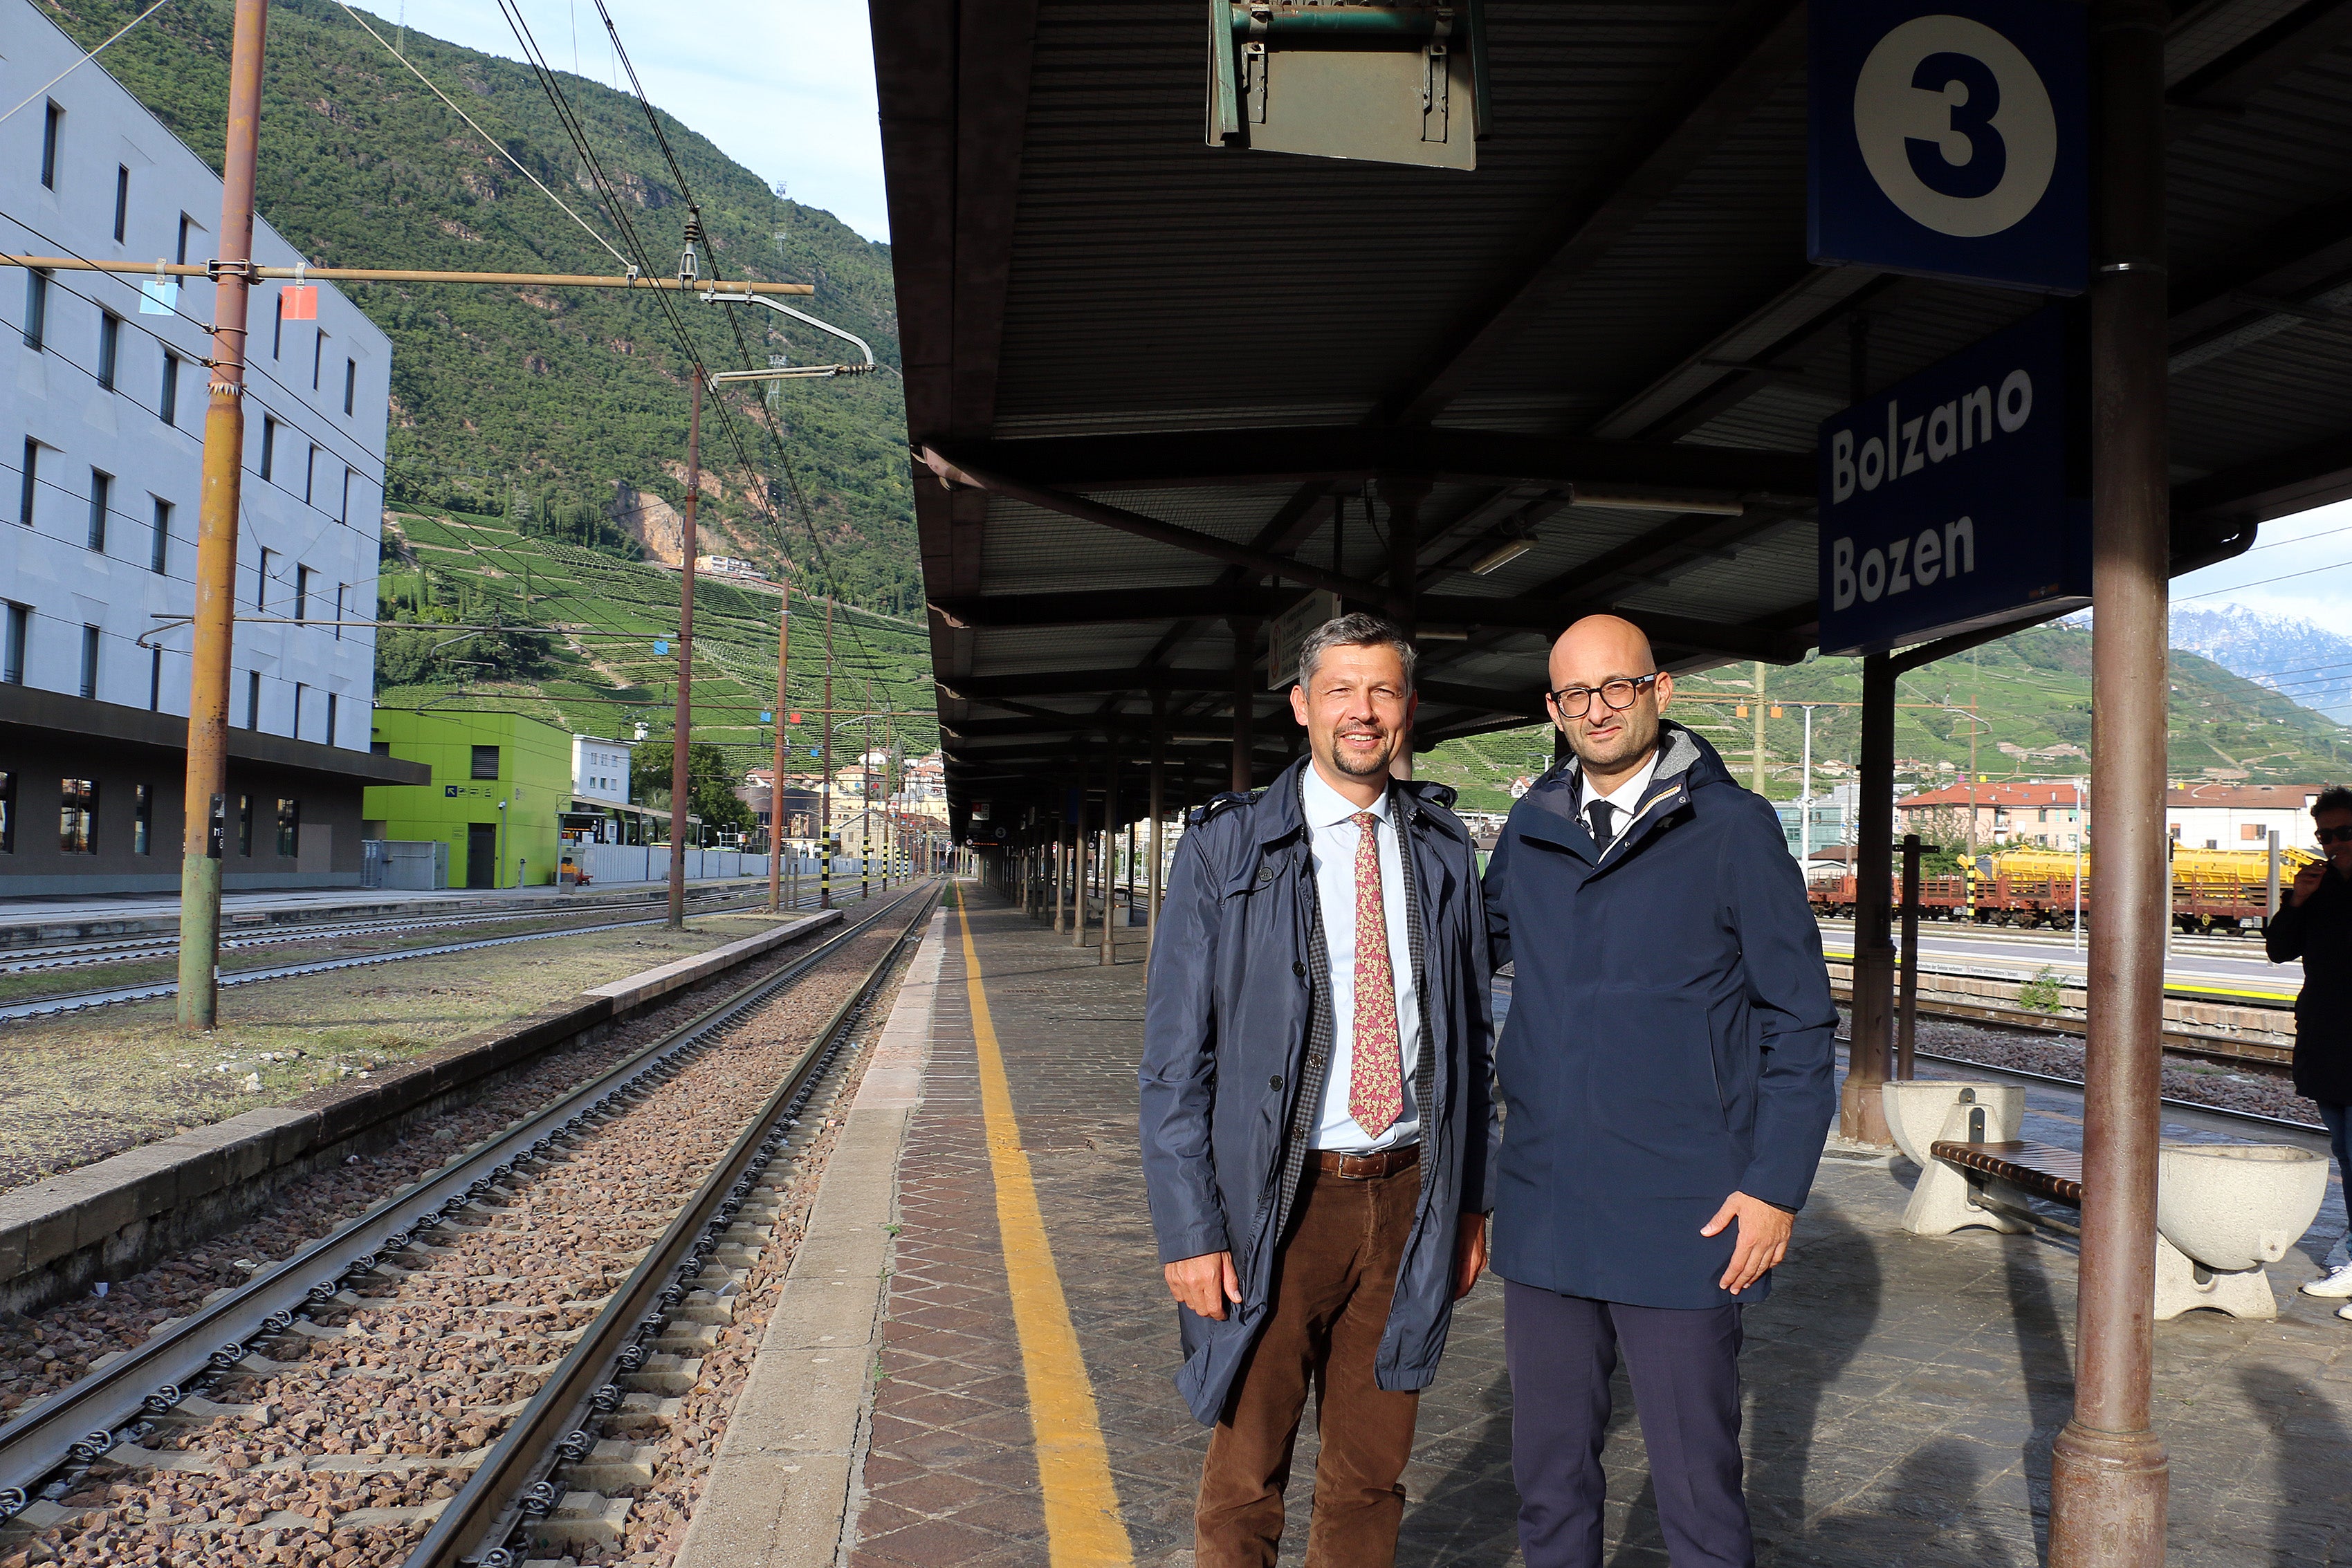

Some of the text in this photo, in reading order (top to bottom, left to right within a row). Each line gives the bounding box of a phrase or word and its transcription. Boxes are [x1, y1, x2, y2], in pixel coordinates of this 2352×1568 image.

[1904, 51, 2007, 199] 3
[1832, 369, 2034, 506] Bolzano
[1832, 515, 1976, 613] Bozen
